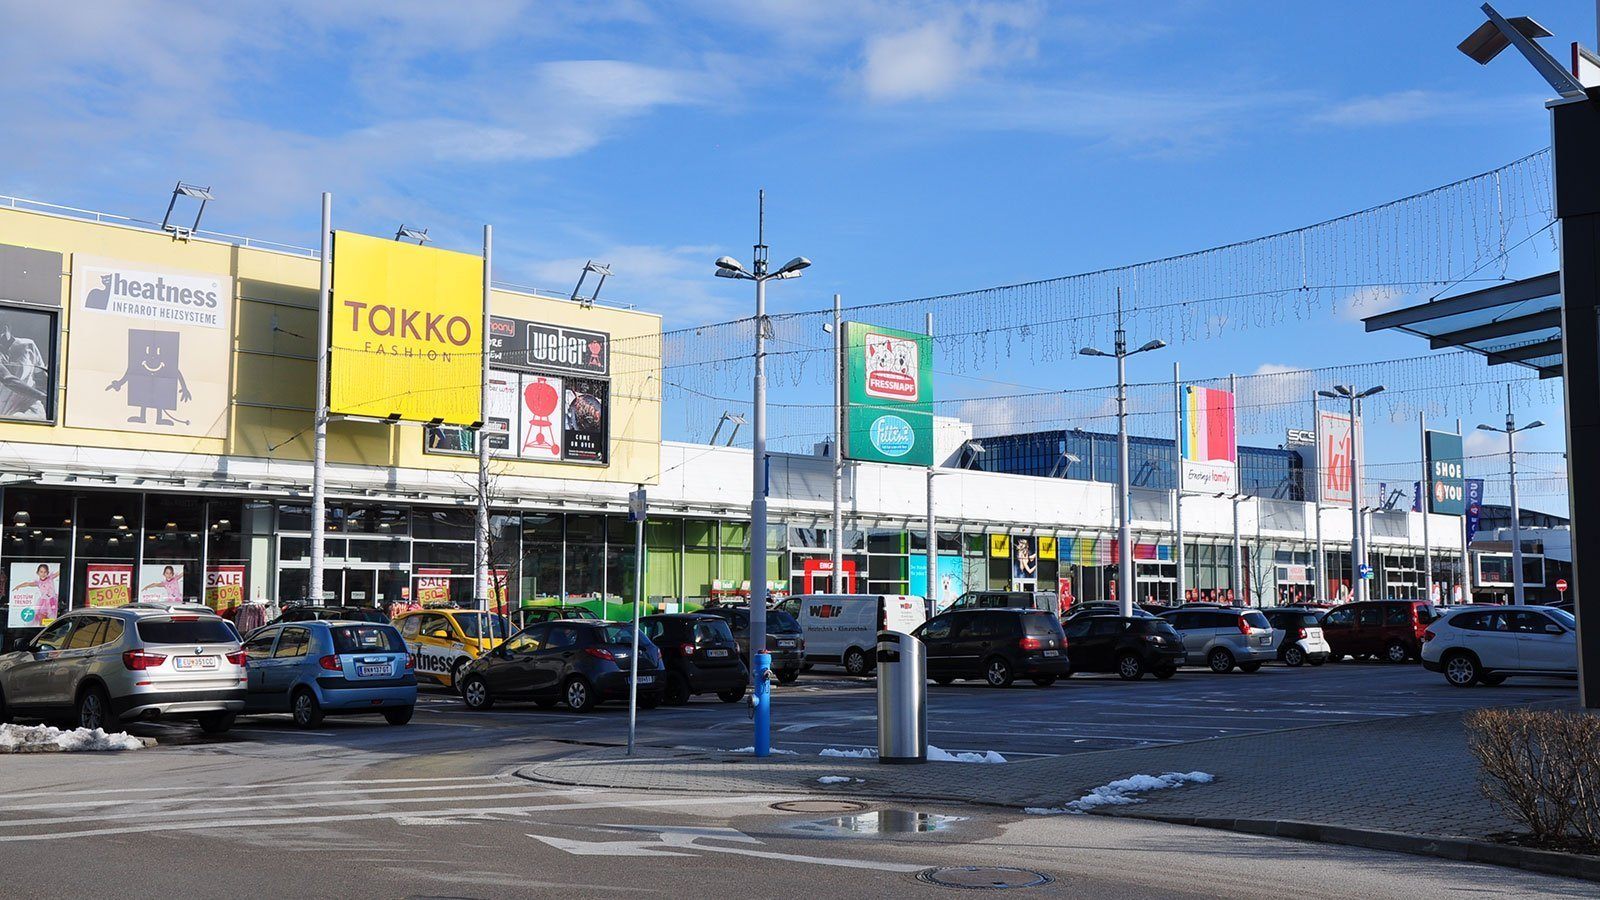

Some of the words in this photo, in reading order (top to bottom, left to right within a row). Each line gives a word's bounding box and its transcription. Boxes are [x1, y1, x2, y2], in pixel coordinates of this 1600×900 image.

[114, 272, 217, 308] heatness
[112, 301, 157, 317] INFRAROT
[159, 308, 217, 325] HEIZSYSTEME
[365, 341, 452, 362] FASHION
[870, 379, 915, 393] FRESSNAPF
[1288, 429, 1315, 442] SCS
[1435, 461, 1462, 478] SHOE
[92, 573, 128, 586] SALE
[207, 573, 241, 586] SALE
[421, 577, 447, 588] SALE
[92, 587, 126, 602] -50%
